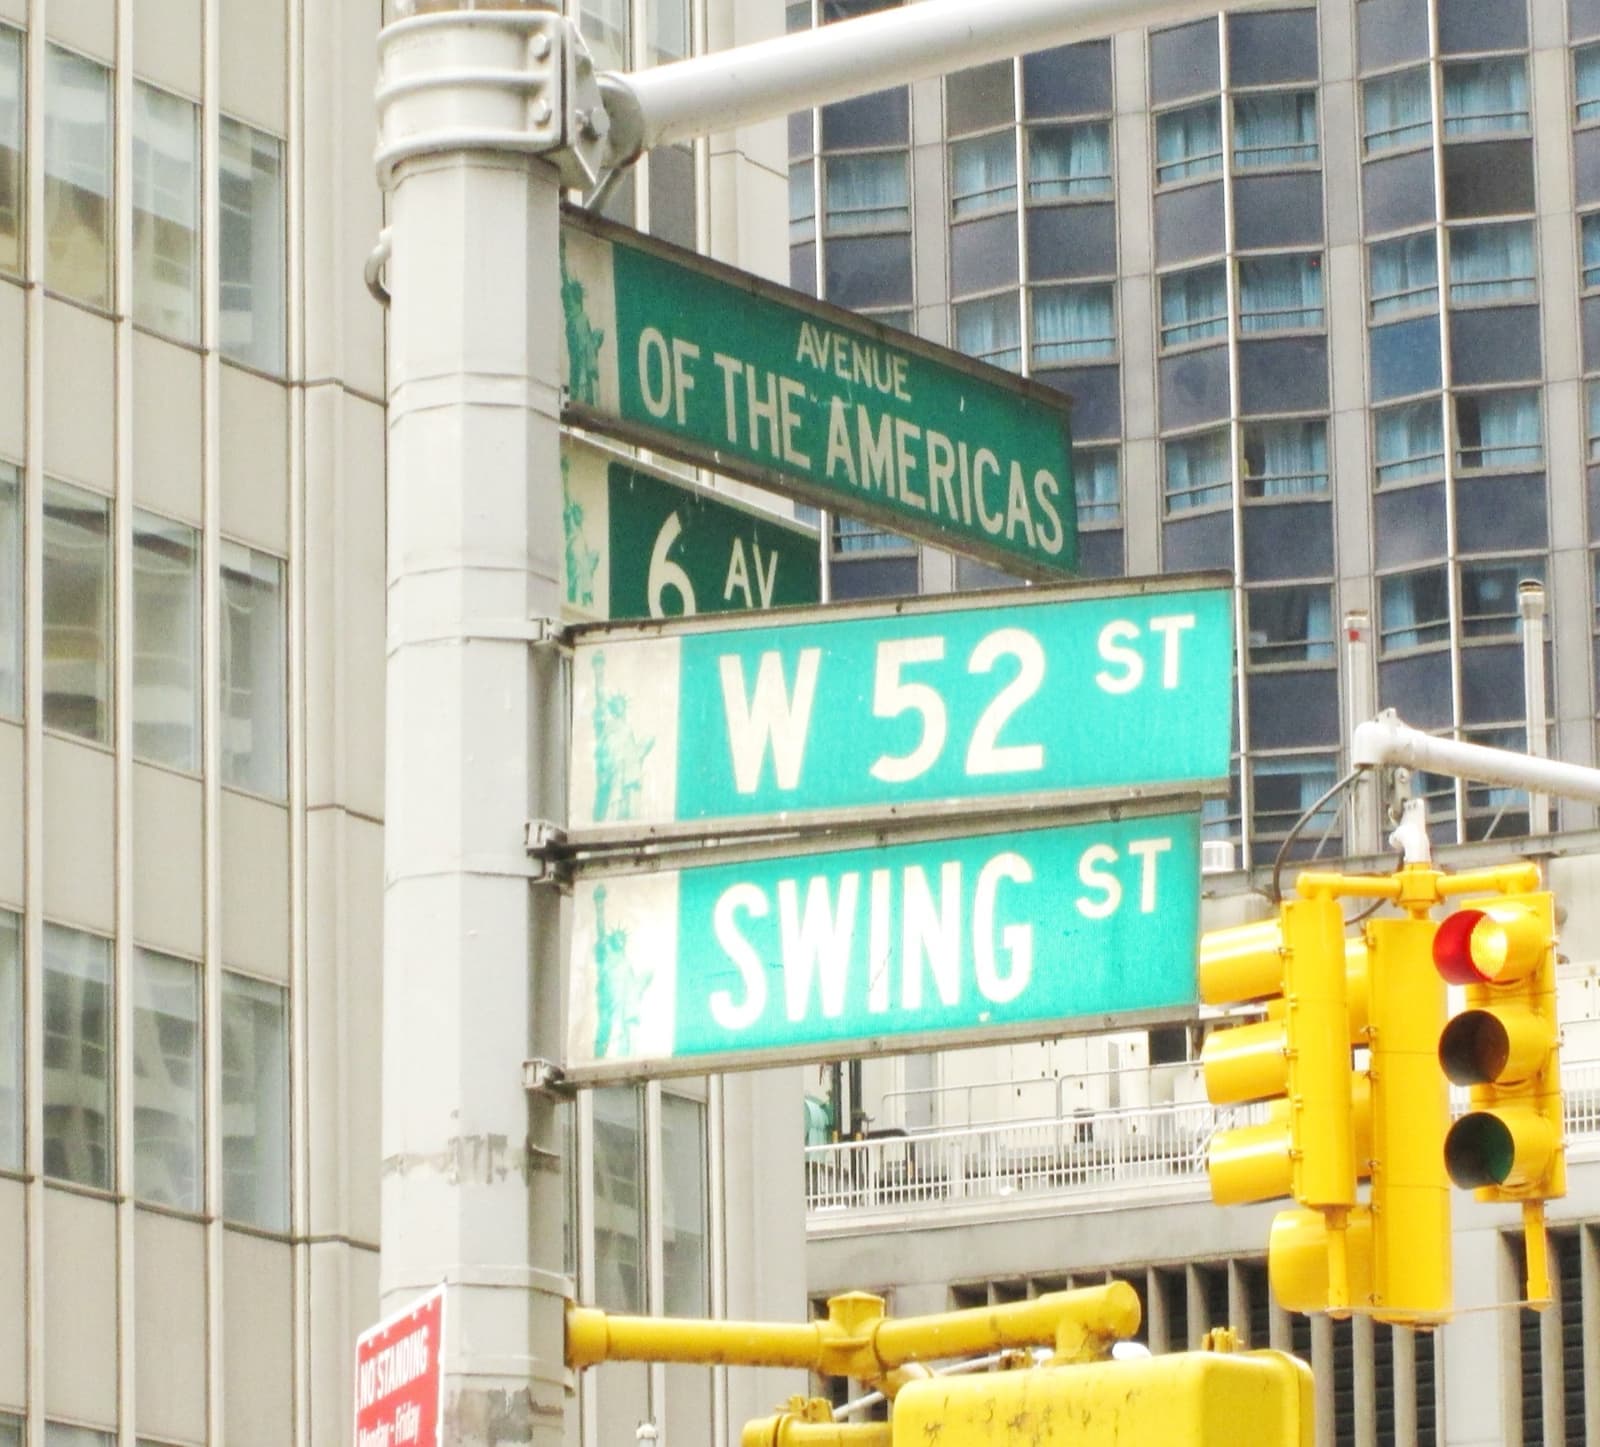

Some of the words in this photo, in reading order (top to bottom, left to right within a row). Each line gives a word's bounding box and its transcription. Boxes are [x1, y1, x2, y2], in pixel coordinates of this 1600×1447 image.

[797, 321, 911, 402] AVENUE
[638, 327, 700, 424] OF
[714, 354, 811, 468] THE
[826, 396, 1064, 555] AMERICAS
[647, 511, 697, 619] 6
[723, 537, 779, 610] AV
[718, 648, 821, 794] W
[869, 627, 1047, 783] 52
[1095, 613, 1196, 696] ST
[709, 852, 1034, 1031] SWING
[1075, 837, 1173, 920] ST
[360, 1358, 376, 1410] NO
[377, 1326, 428, 1400] STANDING
[395, 1400, 421, 1446] Friday
